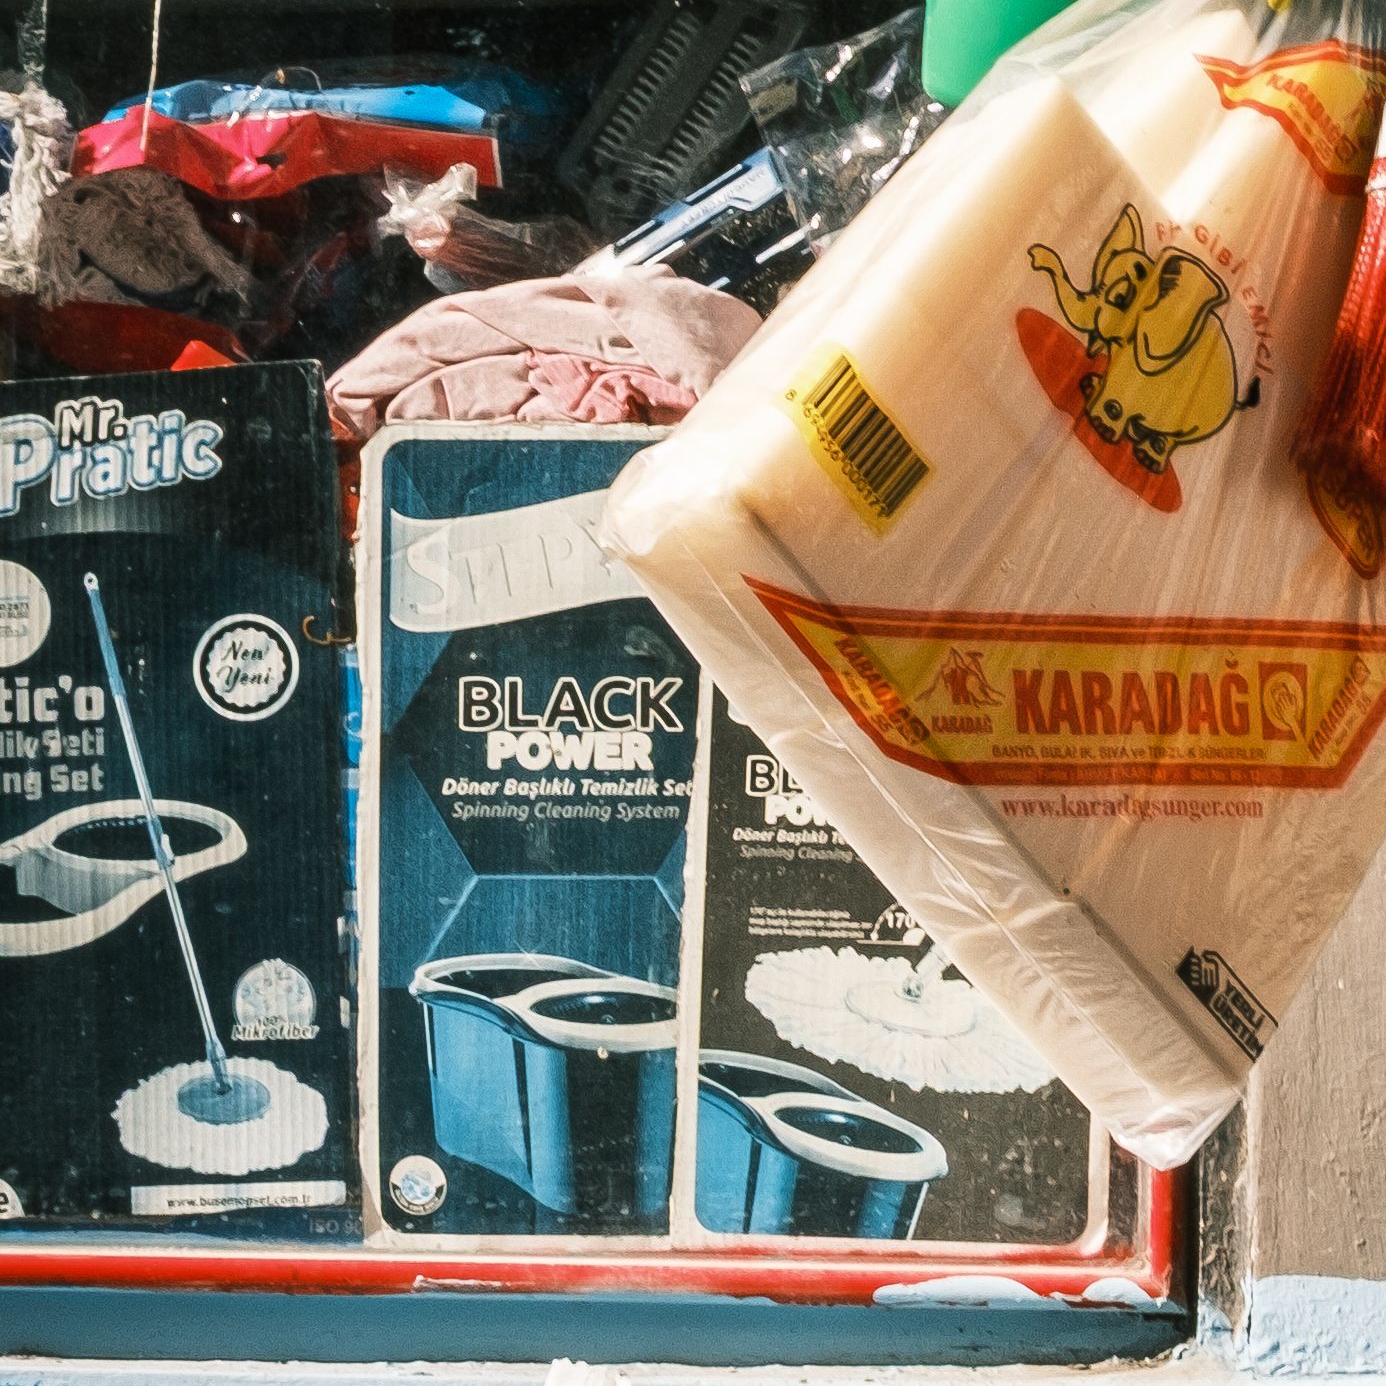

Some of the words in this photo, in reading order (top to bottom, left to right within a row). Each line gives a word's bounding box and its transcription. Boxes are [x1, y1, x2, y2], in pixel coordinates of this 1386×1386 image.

[55, 396, 128, 450] Mr.
[0, 409, 224, 517] Pratic
[458, 675, 684, 733] BLACK
[1012, 654, 1251, 737] KARADAĞ
[486, 729, 654, 771] POWER
[50, 762, 105, 793] Set
[441, 776, 501, 797] Döner
[503, 777, 576, 801] Başlıklı
[580, 776, 659, 797] Temizlik
[451, 800, 531, 822] Spinning
[533, 800, 612, 822] Cleaning
[615, 801, 681, 822] System
[1001, 792, 1264, 822] www.karadagsunger.com
